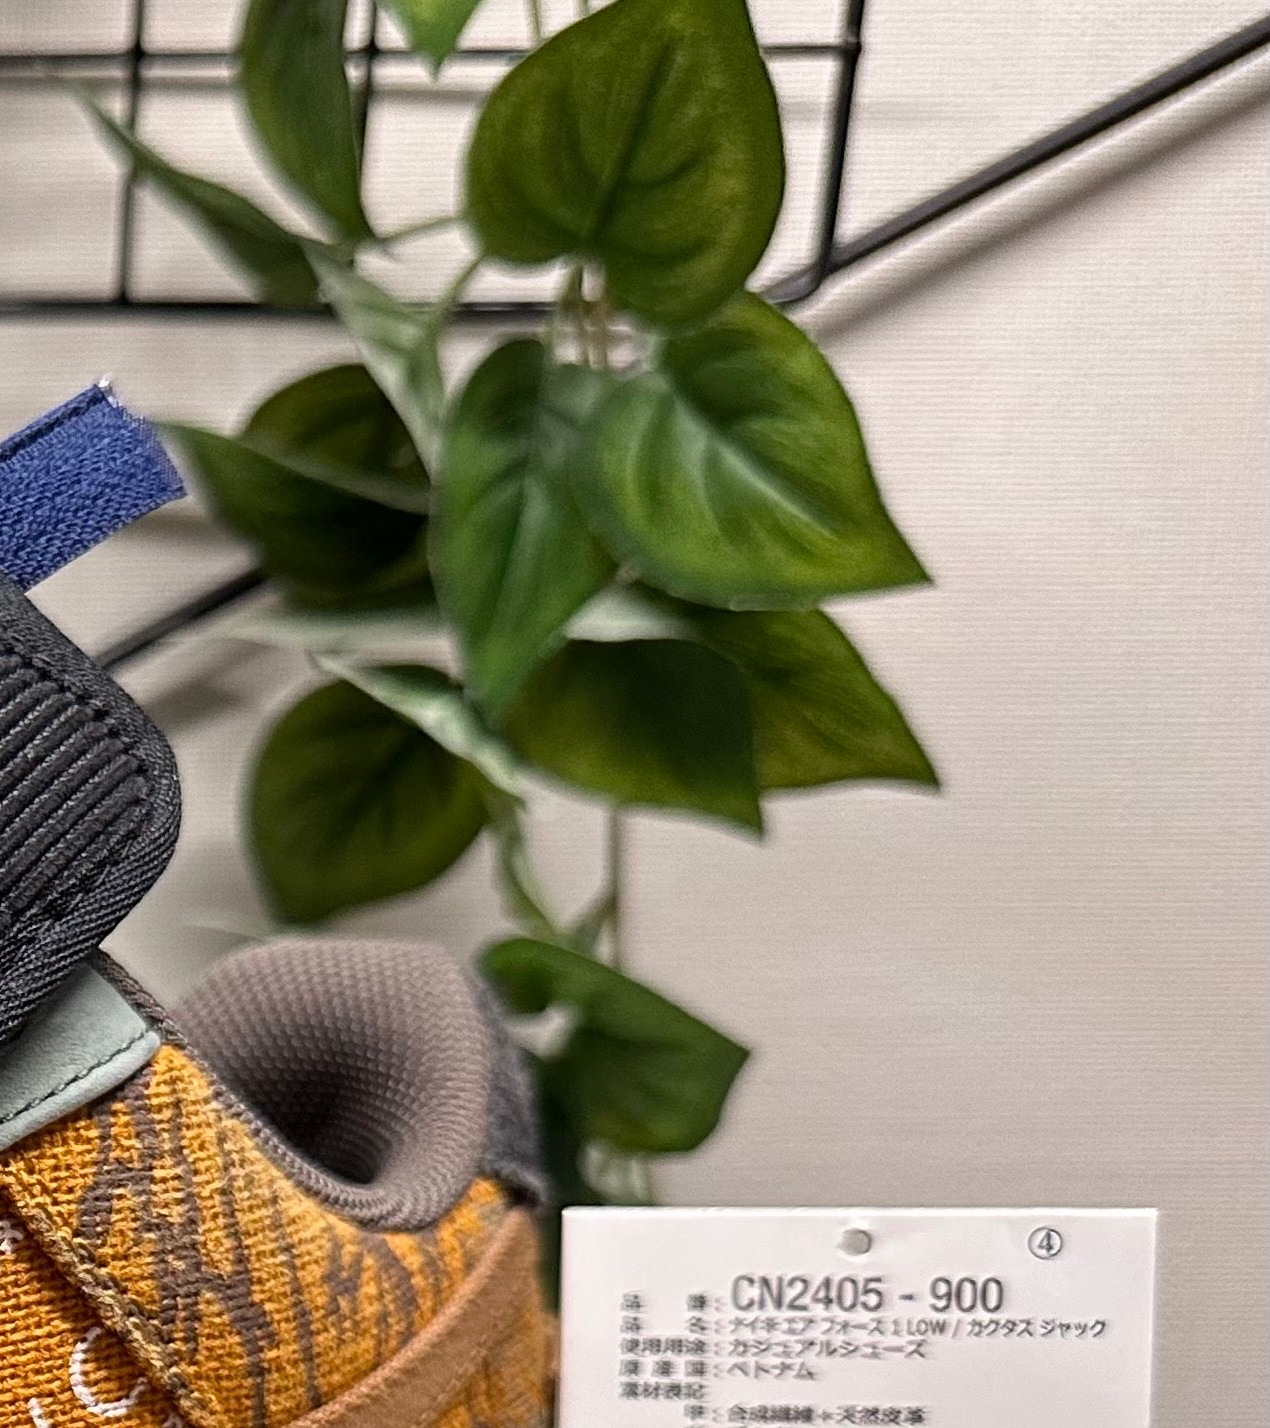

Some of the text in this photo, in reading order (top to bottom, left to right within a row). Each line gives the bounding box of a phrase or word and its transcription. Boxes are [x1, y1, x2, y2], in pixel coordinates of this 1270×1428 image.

[731, 1274, 884, 1312] CN2405
[929, 1276, 1004, 1313] 900
[906, 1318, 948, 1337] LOW
